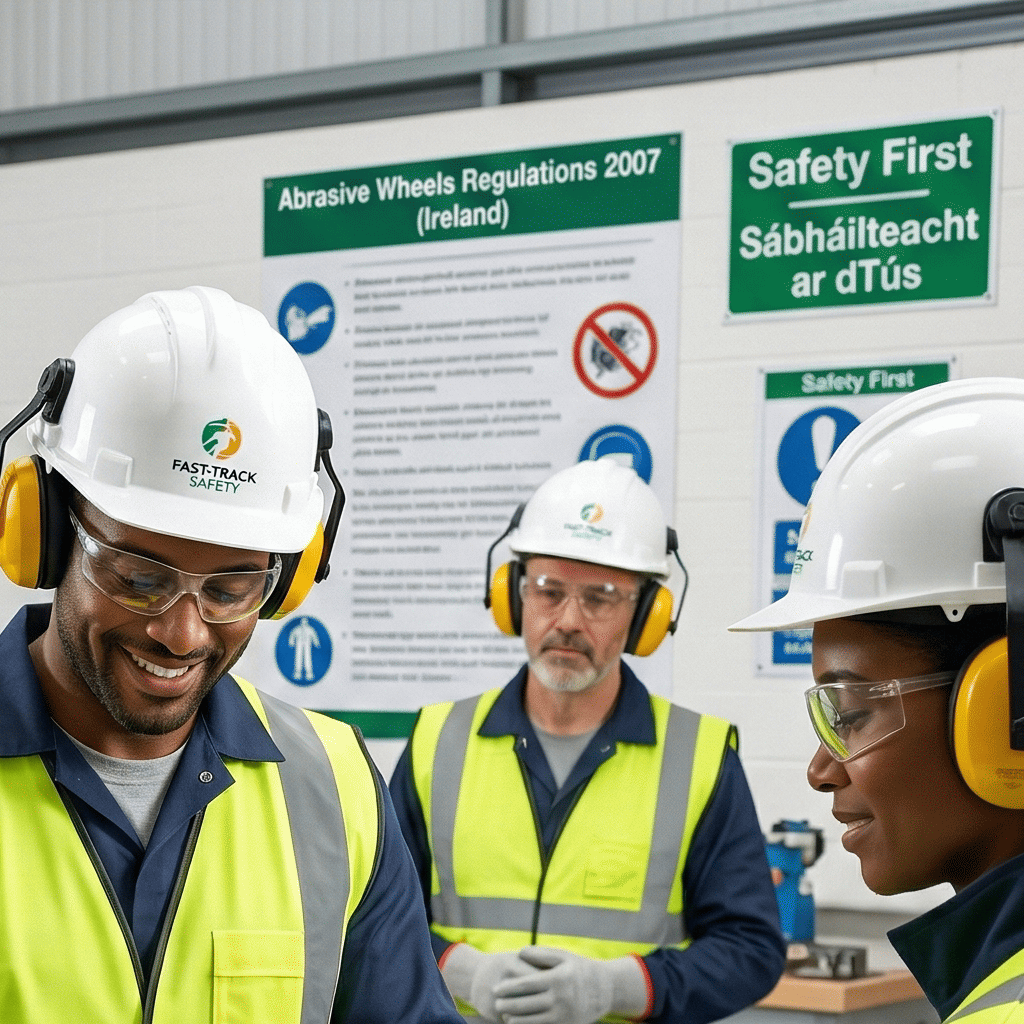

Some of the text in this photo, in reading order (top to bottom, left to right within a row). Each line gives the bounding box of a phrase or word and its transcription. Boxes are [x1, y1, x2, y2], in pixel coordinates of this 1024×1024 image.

[277, 147, 662, 212] Abrasive Wheels Regulations 2007
[748, 132, 973, 190] Safety First
[416, 198, 510, 236] (Ireland)
[739, 207, 980, 260] Sábháilteacht
[790, 254, 923, 298] ar dTús
[801, 369, 916, 395] Safety First
[172, 459, 257, 483] FAST-TRACK
[189, 476, 240, 493] SAFETY
